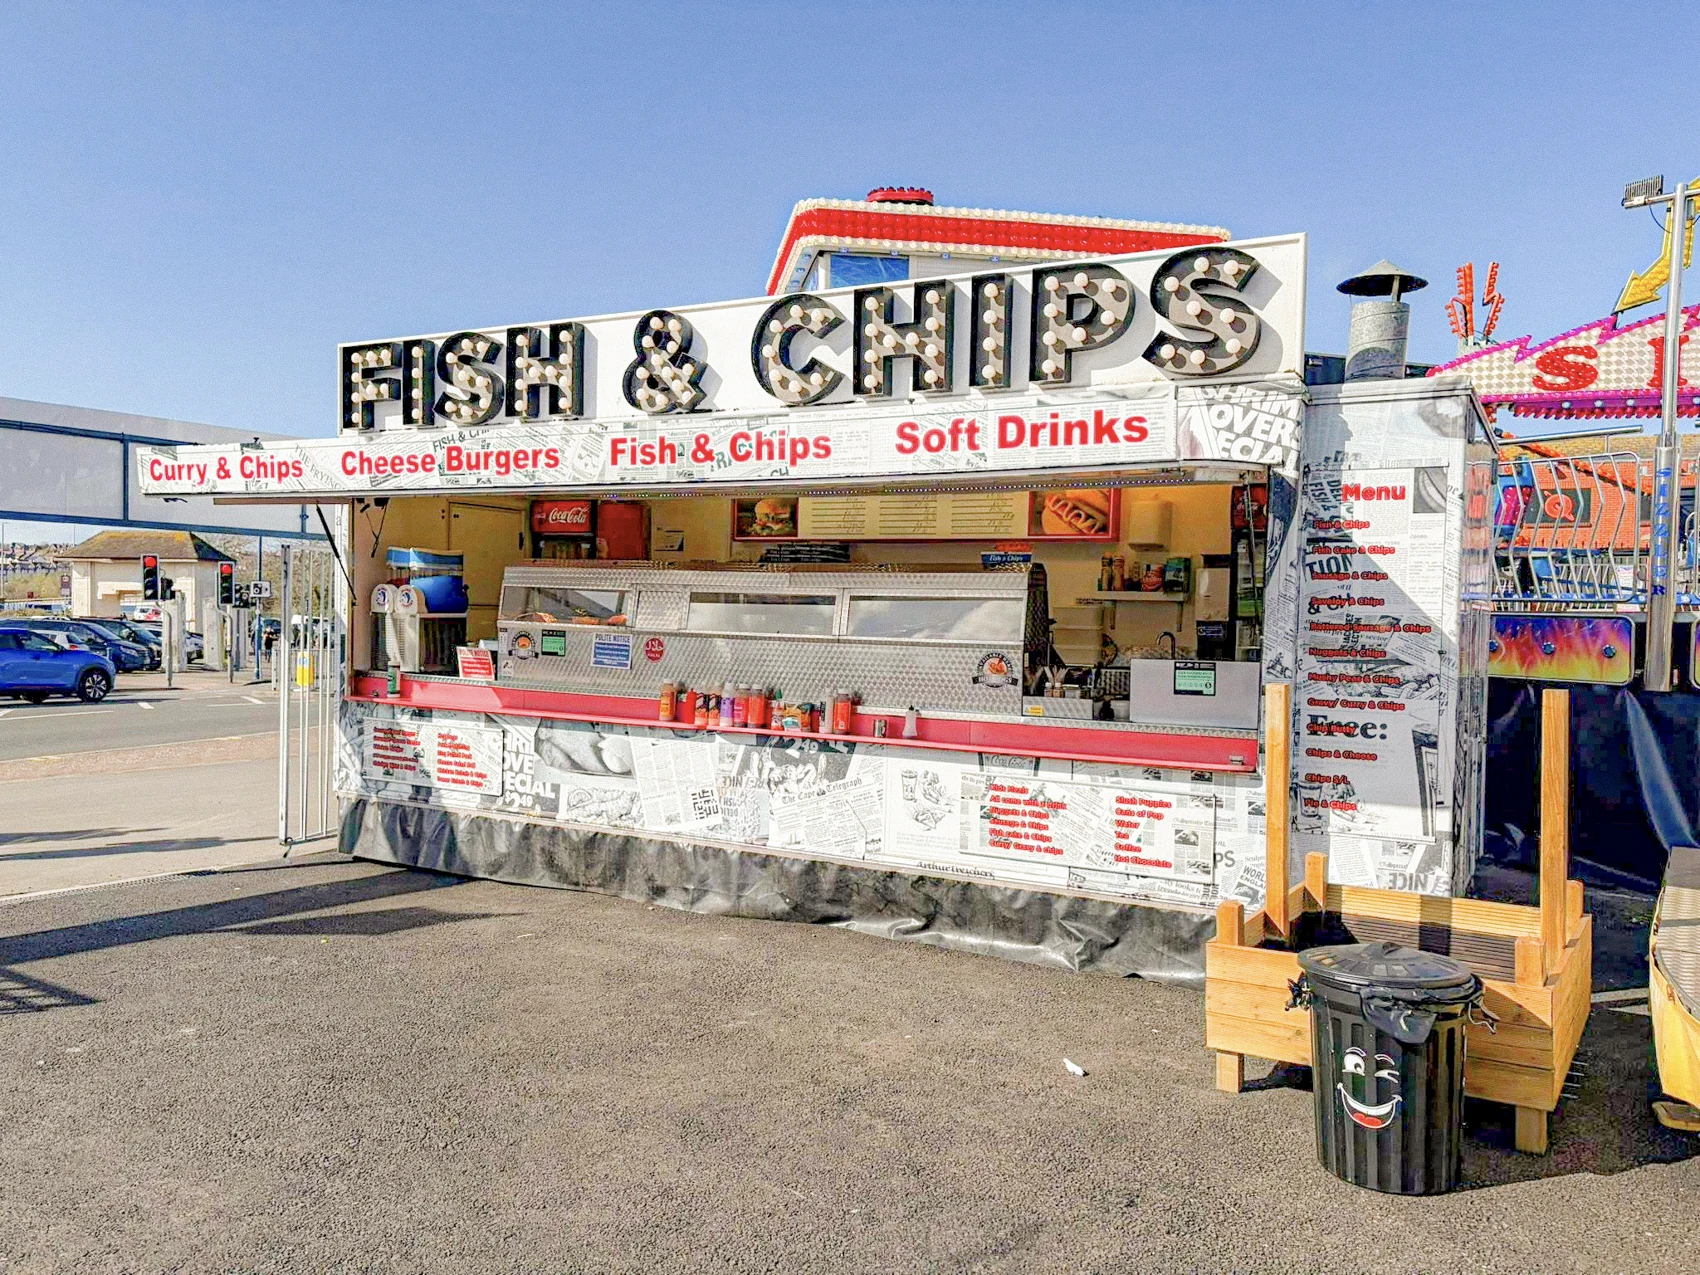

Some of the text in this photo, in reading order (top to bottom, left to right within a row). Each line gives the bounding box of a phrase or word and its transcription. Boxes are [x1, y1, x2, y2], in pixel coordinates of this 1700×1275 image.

[342, 247, 1264, 429] FISH & CHIPS
[896, 410, 1149, 454] Soft Drinks
[611, 436, 677, 466] Fish
[691, 433, 715, 463] &
[730, 430, 831, 467] Chips
[341, 444, 560, 476] Cheese Burgers
[150, 455, 303, 484] Curry & Chips
[1342, 484, 1405, 501] Menu
[1342, 520, 1370, 530] Chips
[1313, 546, 1331, 554] Fish
[1368, 546, 1395, 555] Chips
[1312, 572, 1388, 581] Sausage & Chips
[1311, 597, 1346, 606] Saveloy
[1357, 597, 1385, 607] Chips
[1310, 622, 1351, 631] Battered
[1352, 623, 1392, 633] Sausage
[1394, 624, 1401, 632] &
[1403, 624, 1431, 634] Chips
[1309, 647, 1348, 657] Nuggets
[1359, 648, 1386, 658] Chips
[1308, 673, 1400, 685] Mushy Peas & Chips
[1341, 699, 1367, 709] Curry
[1368, 700, 1376, 709] &
[1377, 700, 1405, 711] Chips
[1305, 748, 1377, 761] Chips & Cheese
[1304, 773, 1332, 784] Chips
[825, 777, 863, 794] Telegraph
[1139, 798, 1172, 808] Puppies
[1304, 799, 1357, 811] Pie & Chips
[1028, 810, 1049, 820] Chips
[1115, 807, 1135, 816] Cans
[1147, 811, 1164, 821] Pop
[1028, 821, 1049, 831] Chips
[1115, 820, 1140, 828] Water
[1031, 833, 1052, 842] Chips
[1115, 831, 1129, 839] Tea
[1115, 842, 1141, 852] Coffee
[1114, 854, 1172, 868] Hot Chocolate
